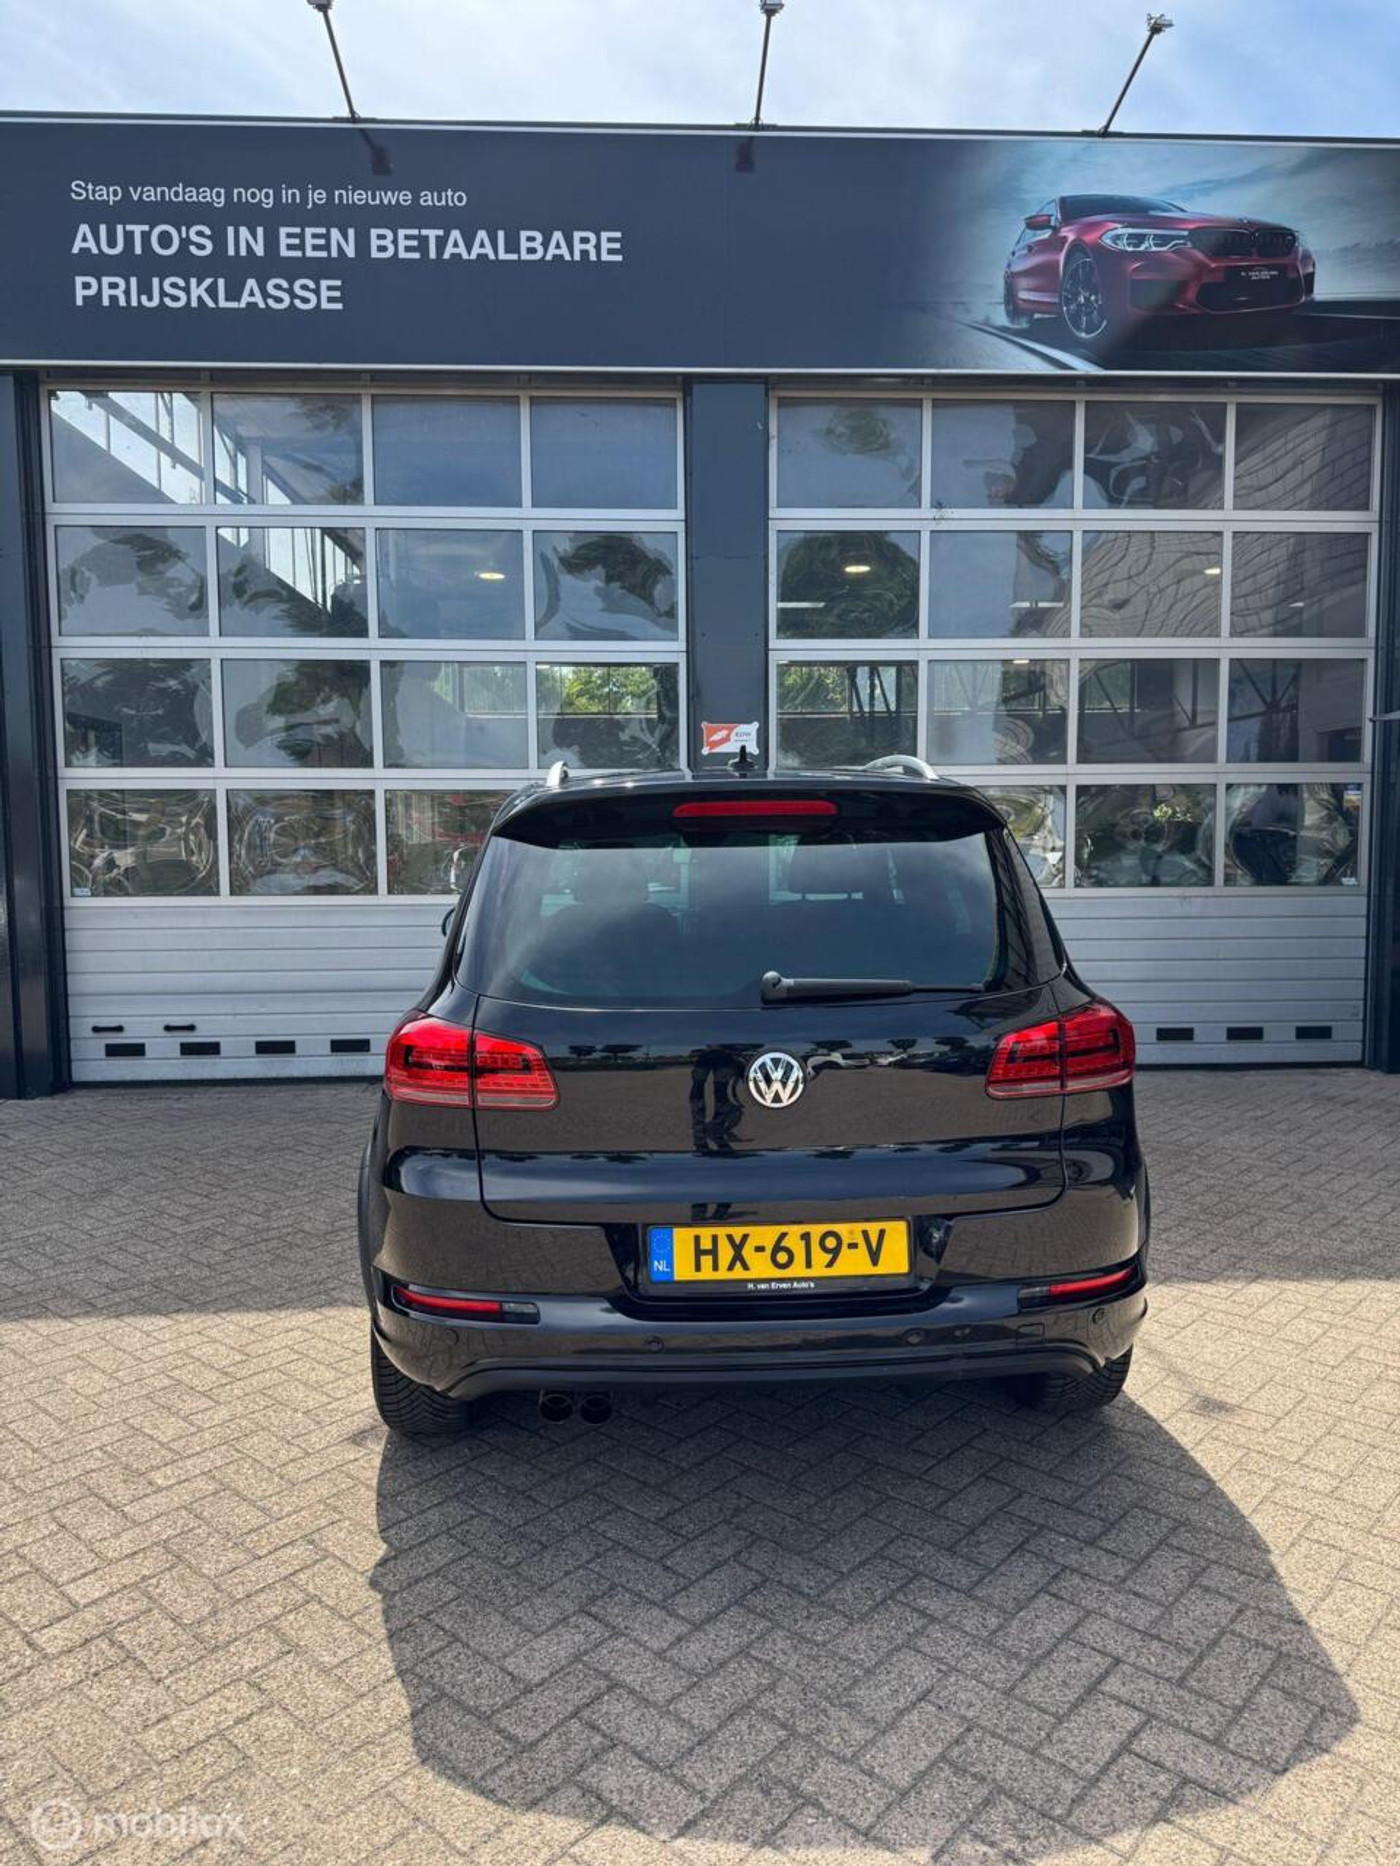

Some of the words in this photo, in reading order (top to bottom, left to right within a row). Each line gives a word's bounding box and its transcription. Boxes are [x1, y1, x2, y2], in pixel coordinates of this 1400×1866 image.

[70, 180, 122, 205] Stap
[129, 182, 225, 208] vandaag
[233, 187, 273, 208] nog
[281, 184, 300, 203] in
[307, 184, 327, 209] je
[334, 186, 412, 206] nieuwe
[419, 188, 467, 207] auto
[71, 223, 214, 256] AUTO'S
[226, 226, 265, 257] IN
[279, 227, 356, 258] EEN
[370, 228, 623, 262] BETAALBARE
[74, 275, 344, 310] PRIJSKLASSE
[653, 1260, 670, 1272] NL
[693, 1228, 887, 1273] HX-619-V
[747, 1282, 756, 1290] H.
[771, 1281, 791, 1289] Erven
[793, 1280, 815, 1288] Auto's
